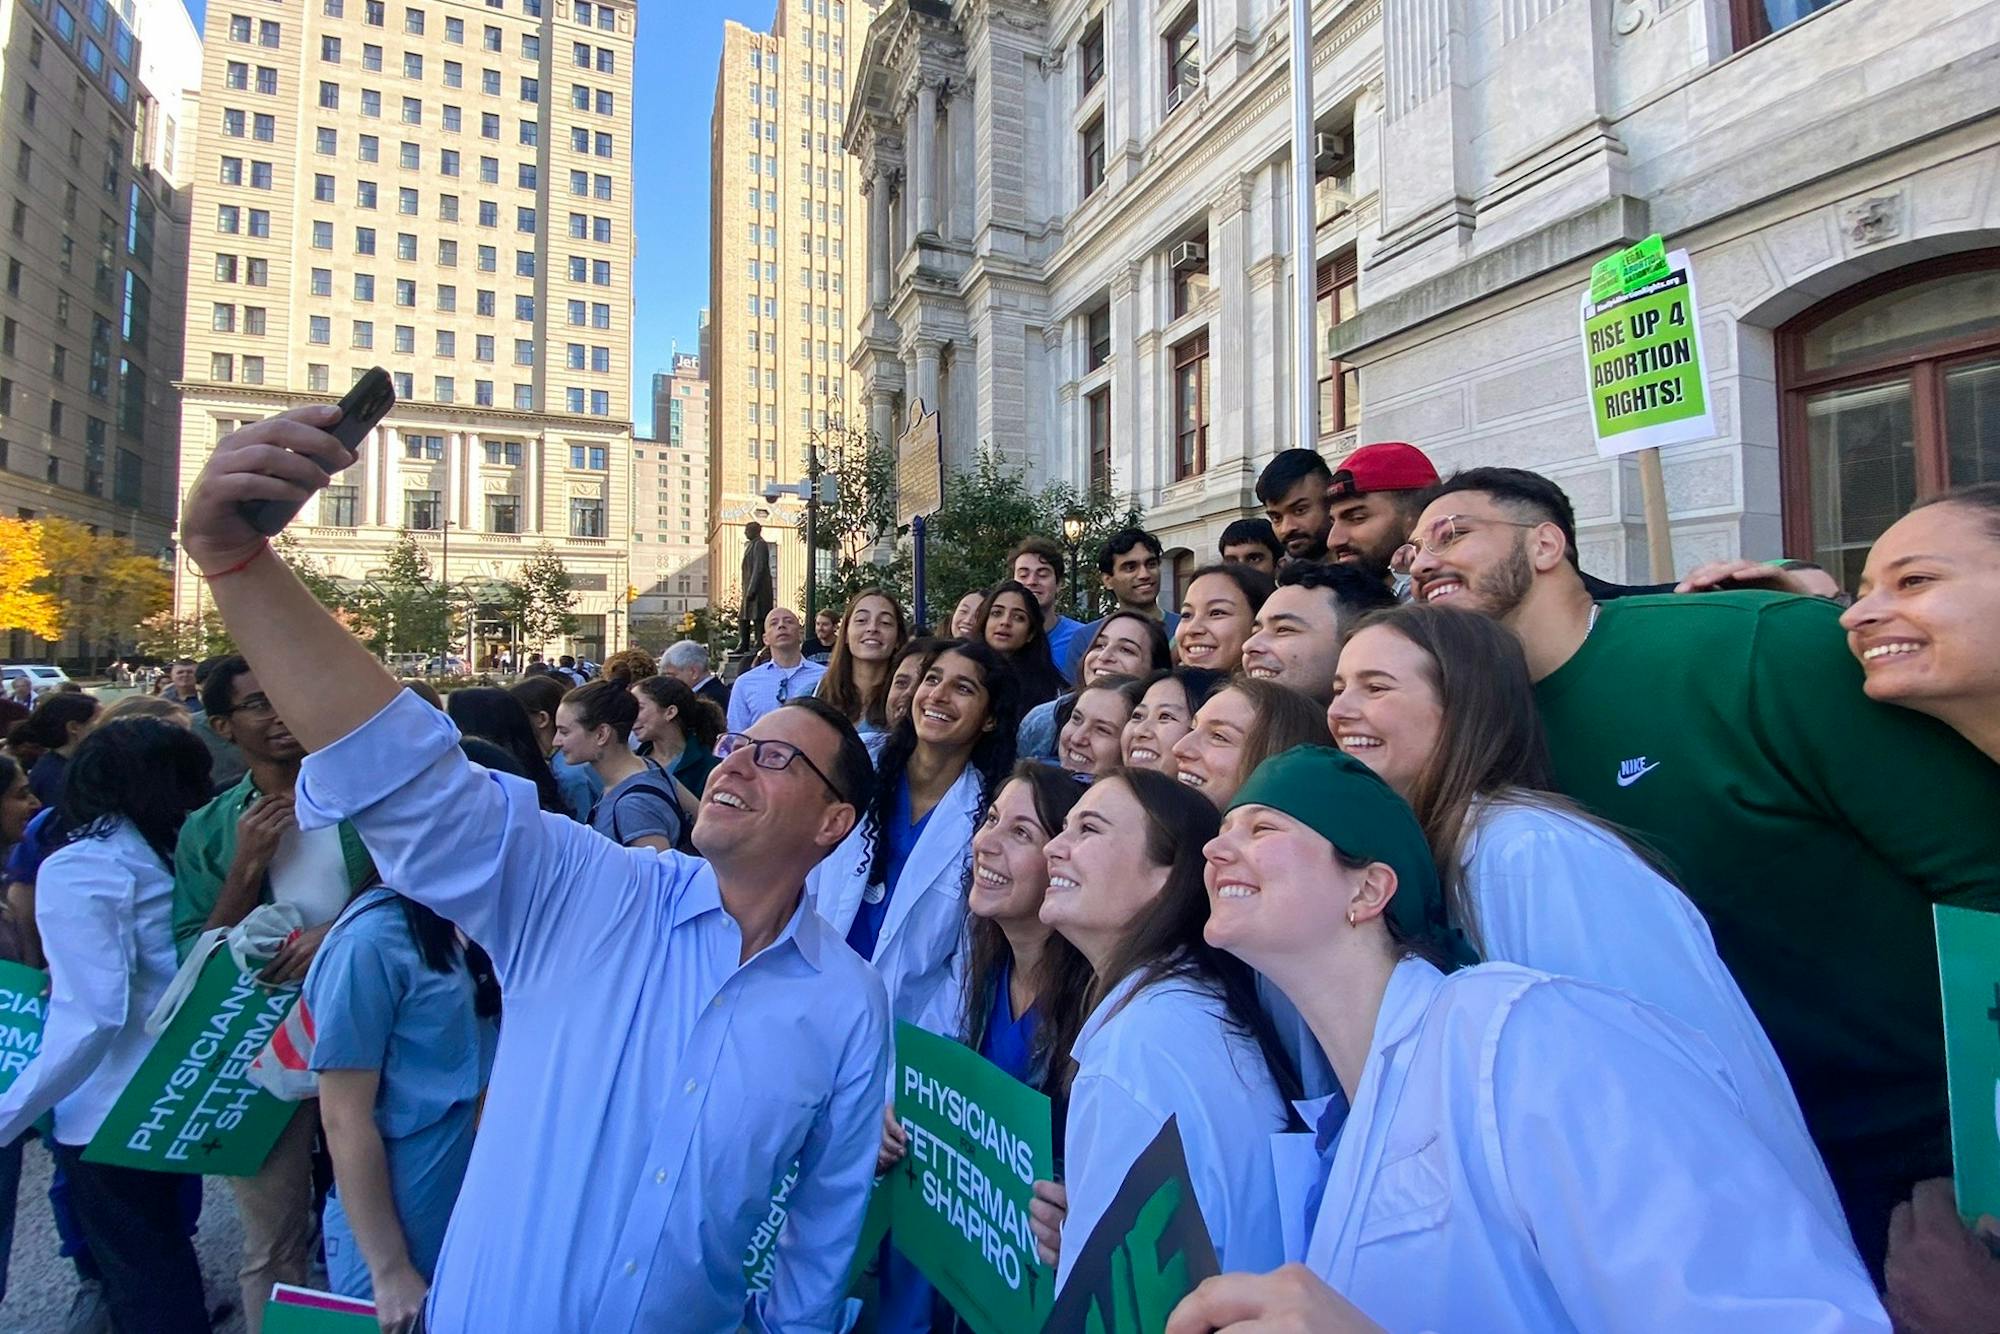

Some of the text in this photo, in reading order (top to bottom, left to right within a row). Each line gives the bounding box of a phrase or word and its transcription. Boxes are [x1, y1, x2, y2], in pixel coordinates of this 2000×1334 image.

[1590, 301, 1685, 355] RISE UP 4
[1594, 337, 1691, 389] ABORTION
[1605, 377, 1683, 419] RIGHTS!
[1621, 756, 1646, 775] NIKE
[904, 1065, 1035, 1185] PHYSICIANS
[922, 1170, 1021, 1290] SHAPIRO
